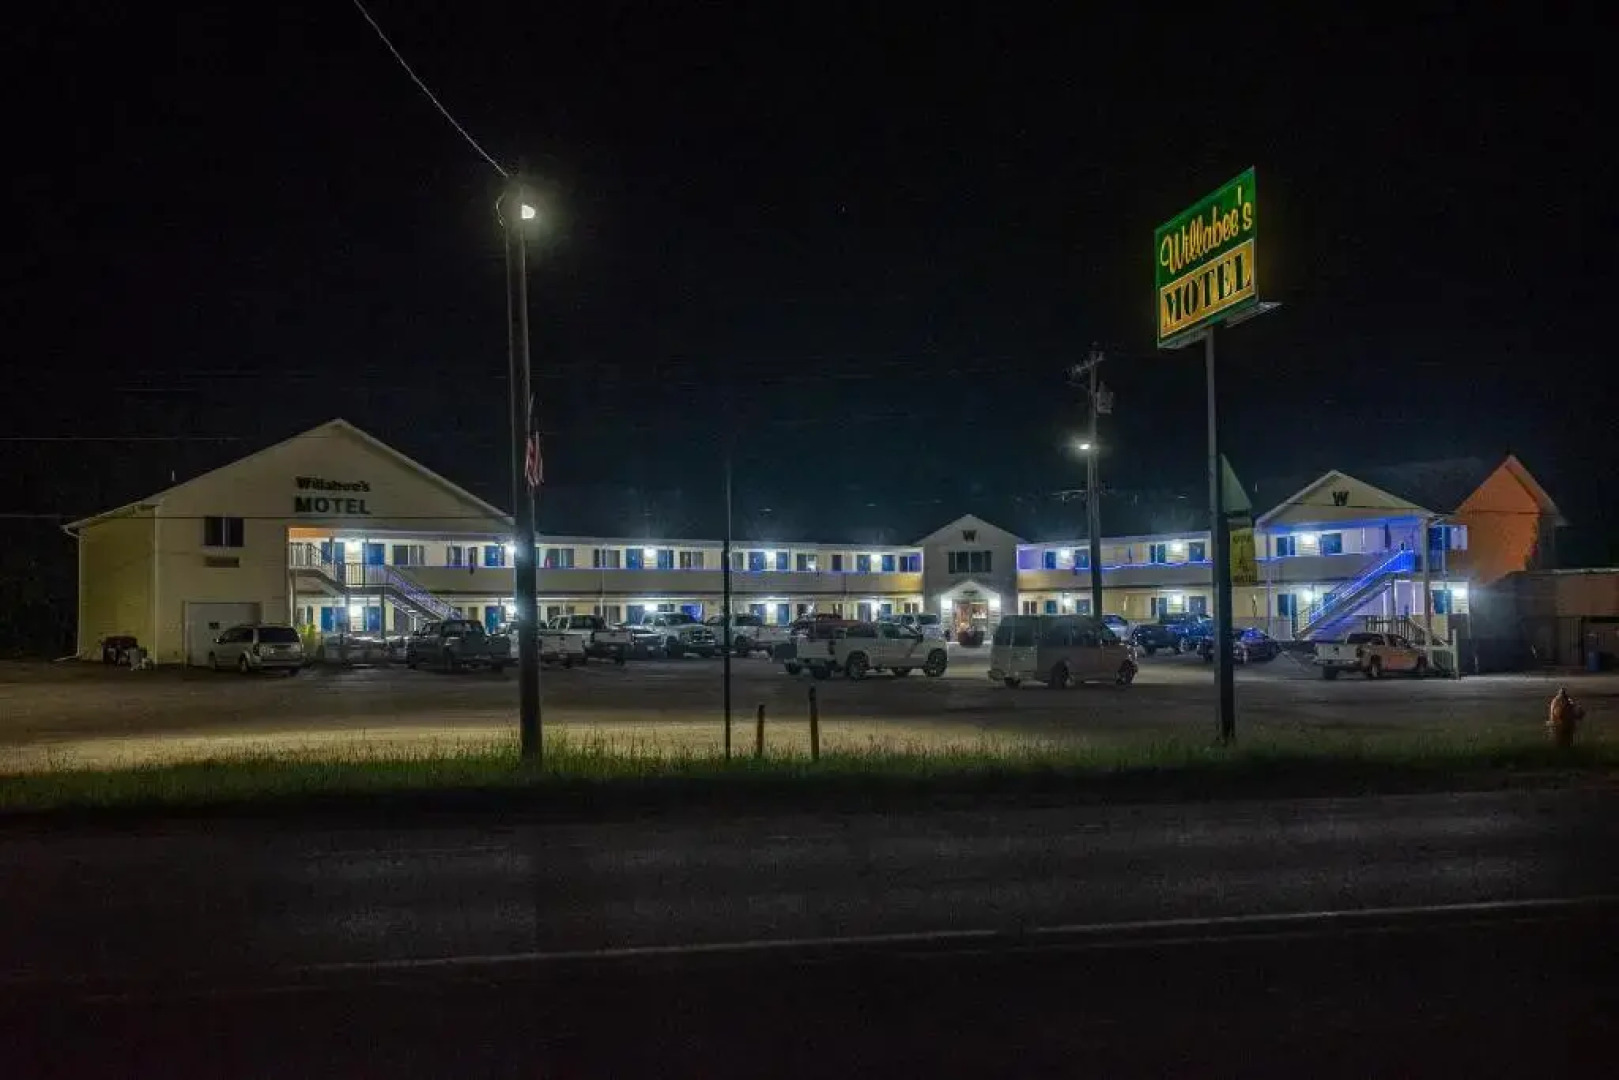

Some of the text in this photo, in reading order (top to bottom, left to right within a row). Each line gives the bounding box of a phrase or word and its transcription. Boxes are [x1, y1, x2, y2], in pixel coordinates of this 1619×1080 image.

[1160, 185, 1253, 275] Willabee's
[1163, 252, 1251, 327] MOTEL
[294, 496, 371, 515] MOTEL
[1332, 490, 1350, 507] W
[962, 529, 977, 542] W
